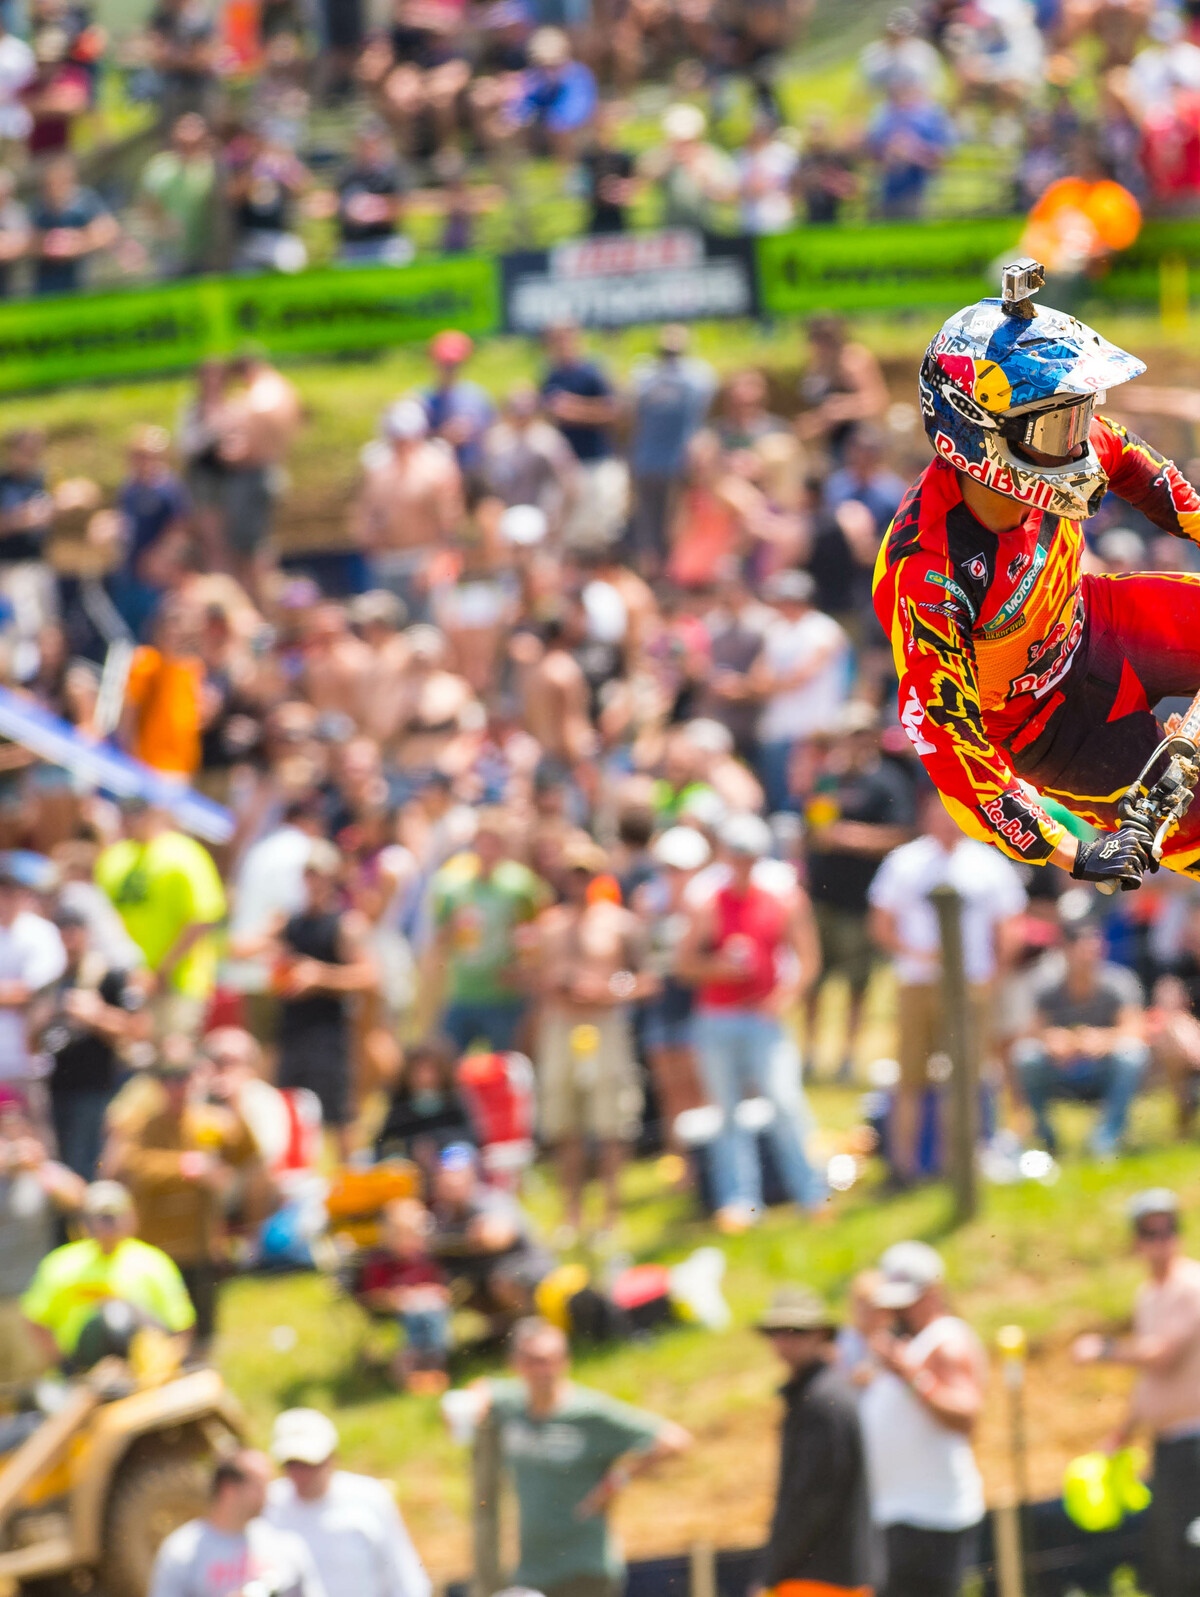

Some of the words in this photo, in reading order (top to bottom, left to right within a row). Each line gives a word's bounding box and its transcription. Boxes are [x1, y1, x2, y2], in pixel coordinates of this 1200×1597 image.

[934, 430, 992, 484] Red
[989, 464, 1054, 509] Bull
[1005, 552, 1045, 614] MOTOREX
[1001, 817, 1038, 852] Bull
